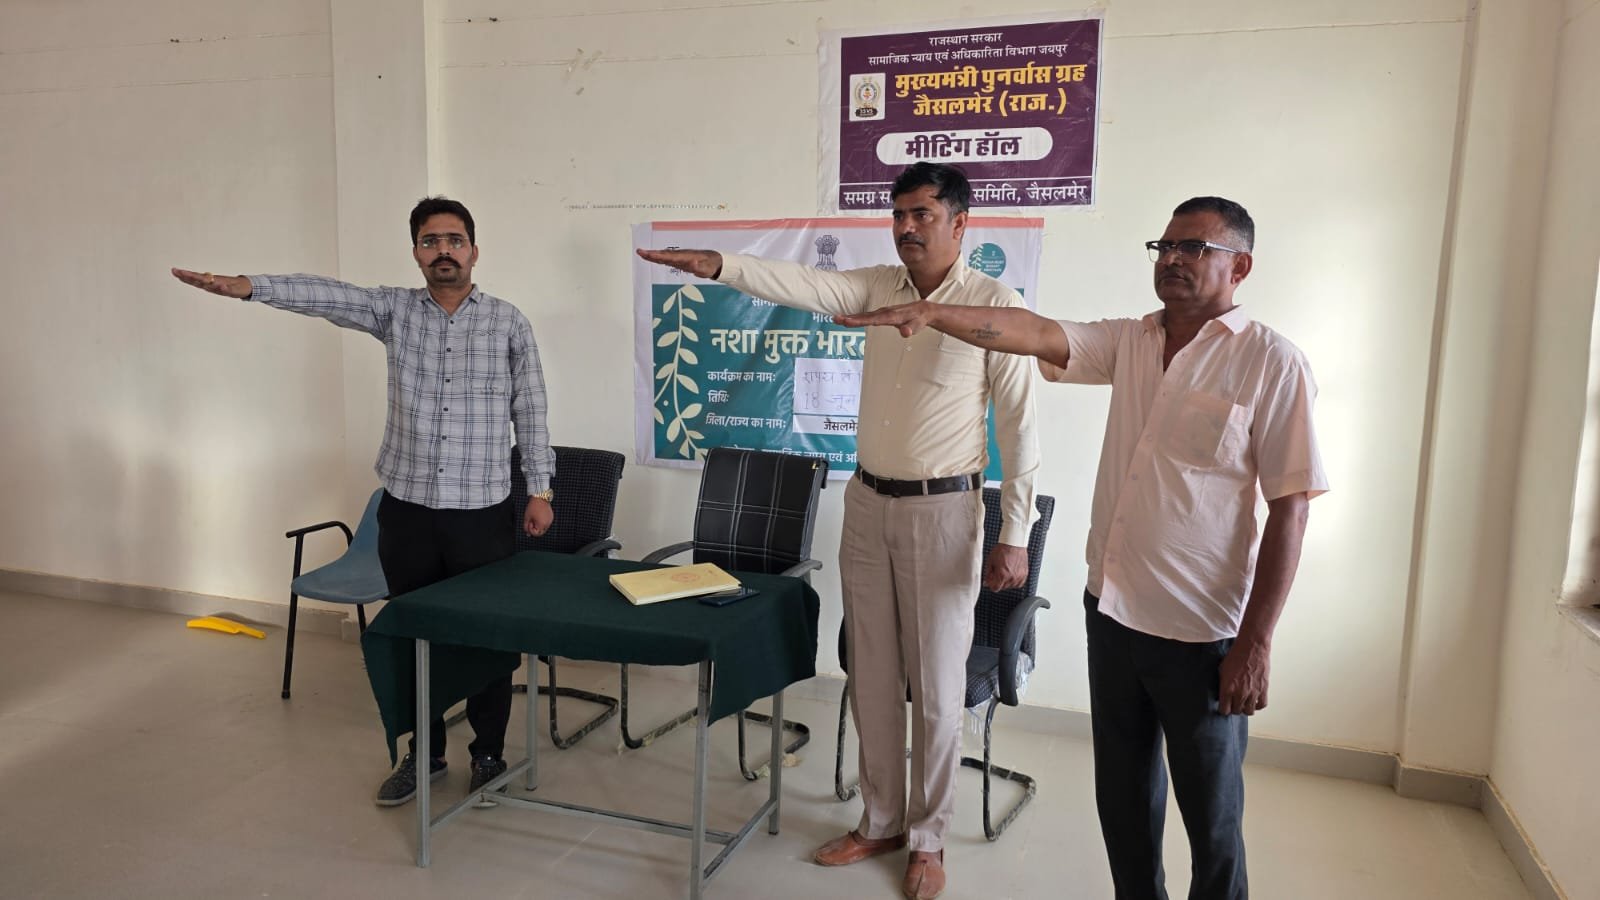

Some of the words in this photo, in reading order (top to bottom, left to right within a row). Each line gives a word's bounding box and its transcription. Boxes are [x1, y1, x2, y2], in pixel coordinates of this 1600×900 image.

[928, 34, 968, 46] राजस्थान
[970, 32, 1003, 43] सरकार
[868, 53, 909, 66] सामाजिक
[911, 52, 932, 62] न्याय
[934, 49, 950, 63] एवं
[951, 46, 1002, 60] अधिकारिता
[1005, 44, 1036, 57] विभाग
[1038, 44, 1068, 57] जयपुर
[895, 66, 979, 98] मुख्यमंत्री
[981, 61, 1053, 93] पुनर्वास
[1055, 64, 1088, 83] ग्रह
[913, 92, 994, 116] जैसलमेर
[999, 87, 1067, 117] (राज.)
[905, 132, 972, 159] मीटिंग
[975, 131, 1022, 156] हॉल
[843, 191, 876, 205] समग्र
[1026, 180, 1087, 201] जैसलमेर
[710, 329, 759, 354] नशा
[764, 329, 810, 364] मुक्त
[706, 368, 741, 382] कार्यक्रम
[743, 371, 755, 382] का
[750, 417, 764, 428] का
